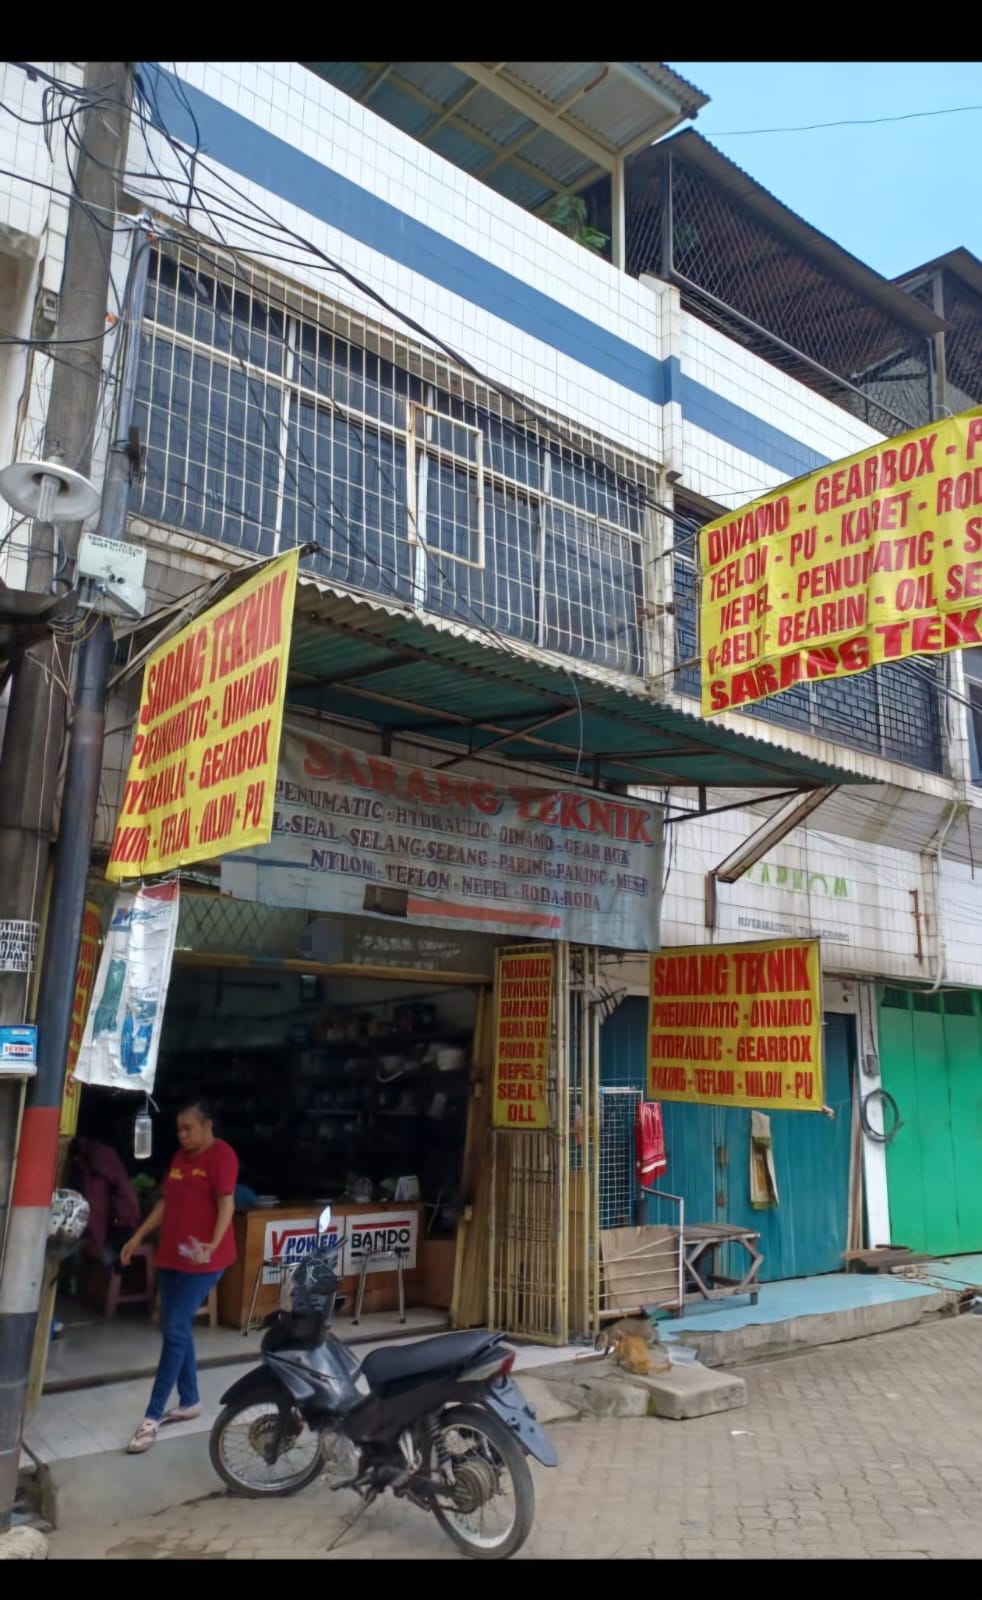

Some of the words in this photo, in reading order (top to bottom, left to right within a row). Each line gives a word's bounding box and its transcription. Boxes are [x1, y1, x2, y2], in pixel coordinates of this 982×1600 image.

[707, 496, 790, 566] DINAMO
[814, 433, 938, 515] GEARBOX
[710, 545, 768, 602] TEFLON
[790, 525, 817, 567] PU
[840, 490, 912, 548] KARET
[895, 572, 937, 611] OIL
[141, 625, 207, 726] SARANG
[210, 570, 288, 685] TEKNIK
[221, 656, 279, 729] DINAMO
[710, 636, 869, 711] SARANG
[198, 718, 271, 790] GEARBOX
[243, 780, 265, 831] PU
[303, 740, 499, 816] SARANG
[508, 783, 653, 846] TEKNIK
[310, 848, 373, 876] NYLON
[385, 864, 449, 890] TEFLON
[654, 953, 728, 997] SARANG
[733, 947, 811, 995] TEKNIK
[750, 998, 812, 1028] DINAMO
[651, 1033, 722, 1061] HYDRAULIC
[736, 1035, 813, 1062] GEARBOX
[497, 1082, 536, 1100] SEAL
[695, 1068, 734, 1096] TEFLON
[745, 1071, 782, 1098] NILON
[795, 1071, 813, 1100] PU
[351, 1228, 411, 1251] BANDO
